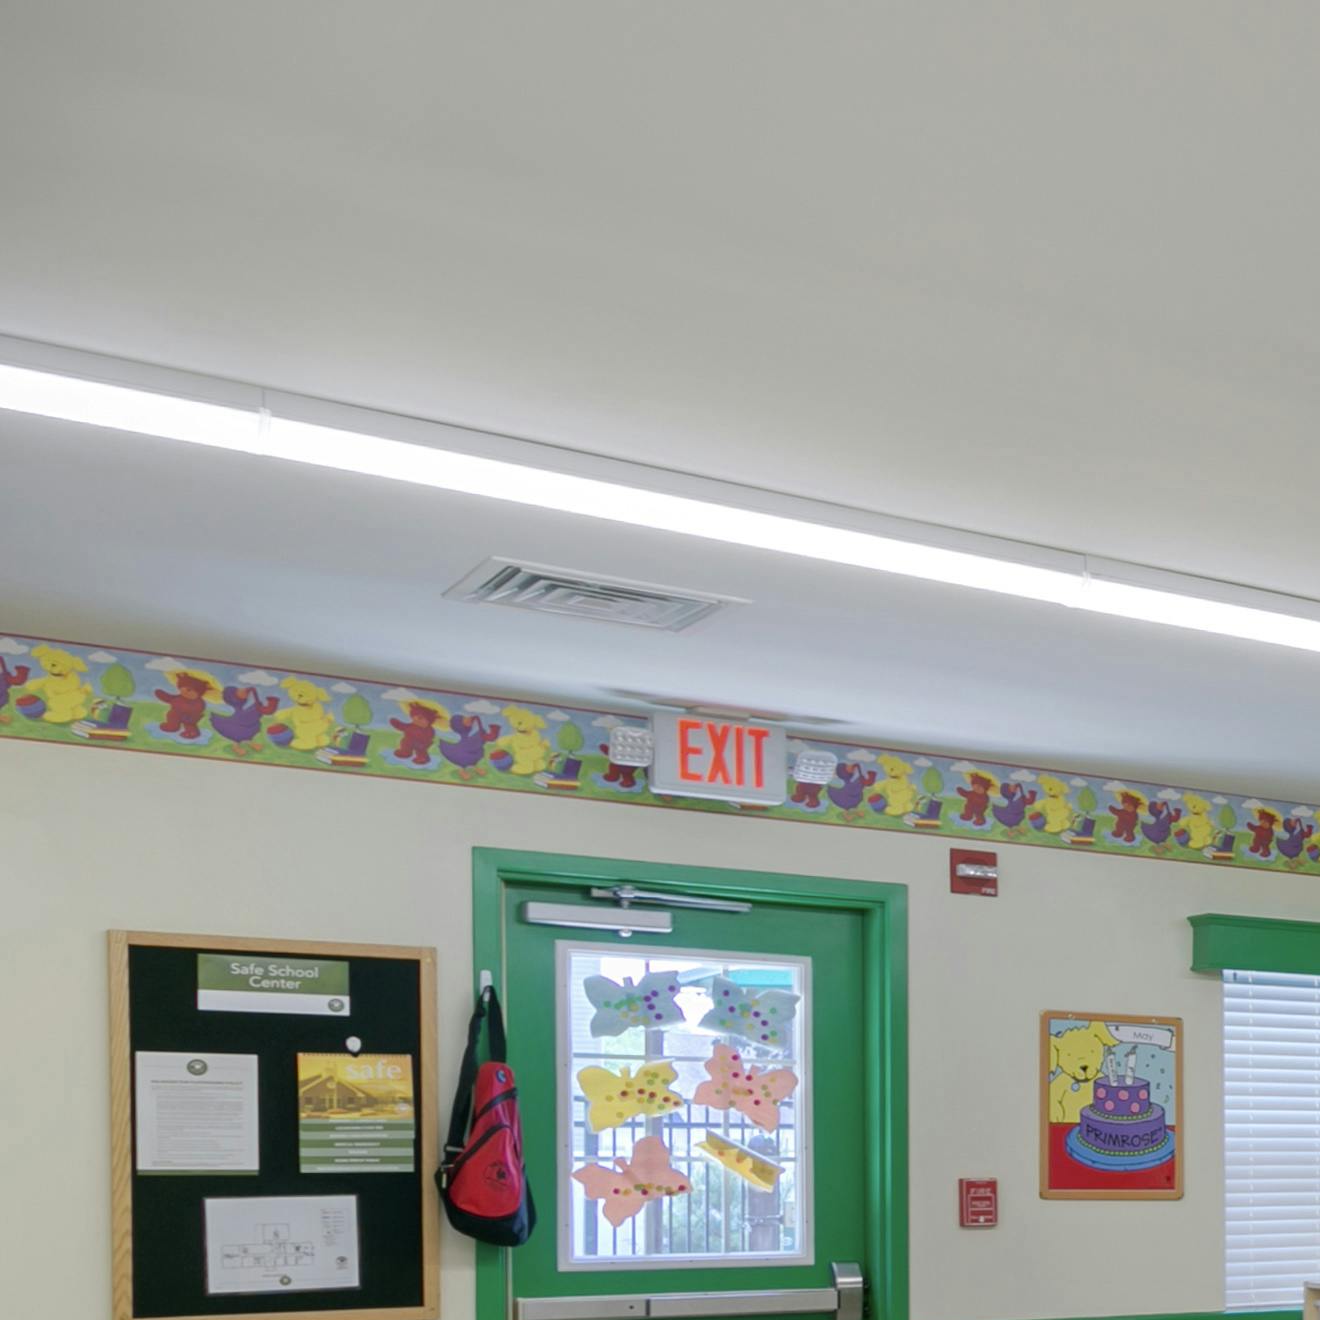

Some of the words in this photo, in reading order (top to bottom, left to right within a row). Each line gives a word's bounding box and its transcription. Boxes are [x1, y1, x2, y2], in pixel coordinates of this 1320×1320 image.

[678, 718, 769, 788] EXIT
[230, 962, 264, 976] Safe
[267, 964, 319, 979] School
[248, 976, 302, 990] Center
[345, 1060, 401, 1080] safe
